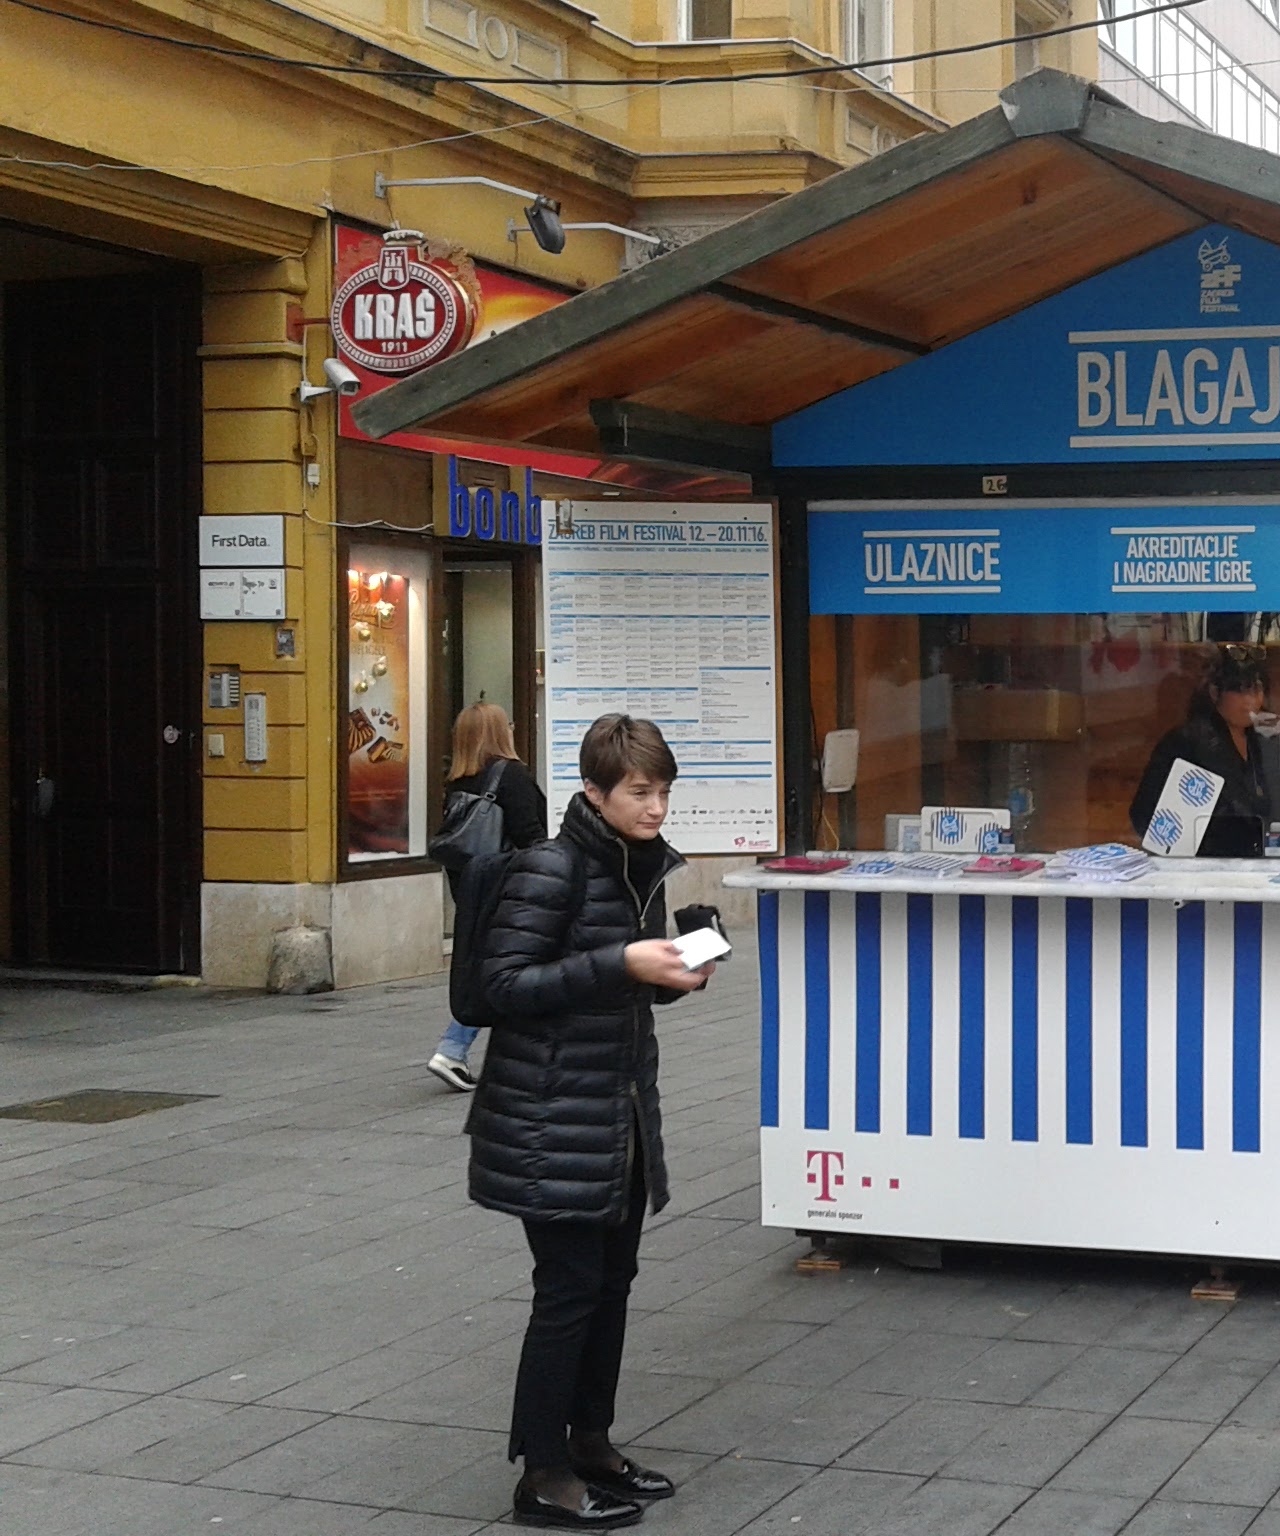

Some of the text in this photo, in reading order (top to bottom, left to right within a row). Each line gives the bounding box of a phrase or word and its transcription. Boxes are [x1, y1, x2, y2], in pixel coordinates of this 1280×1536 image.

[381, 341, 409, 353] 1911
[211, 534, 237, 547] First
[600, 525, 629, 540] FILM
[633, 525, 687, 541] FESTIVAL
[1126, 535, 1240, 559] AKREDITACIJE
[864, 541, 1001, 583] ULAZNICE
[1114, 560, 1253, 584] I NAGRADNE IGRE
